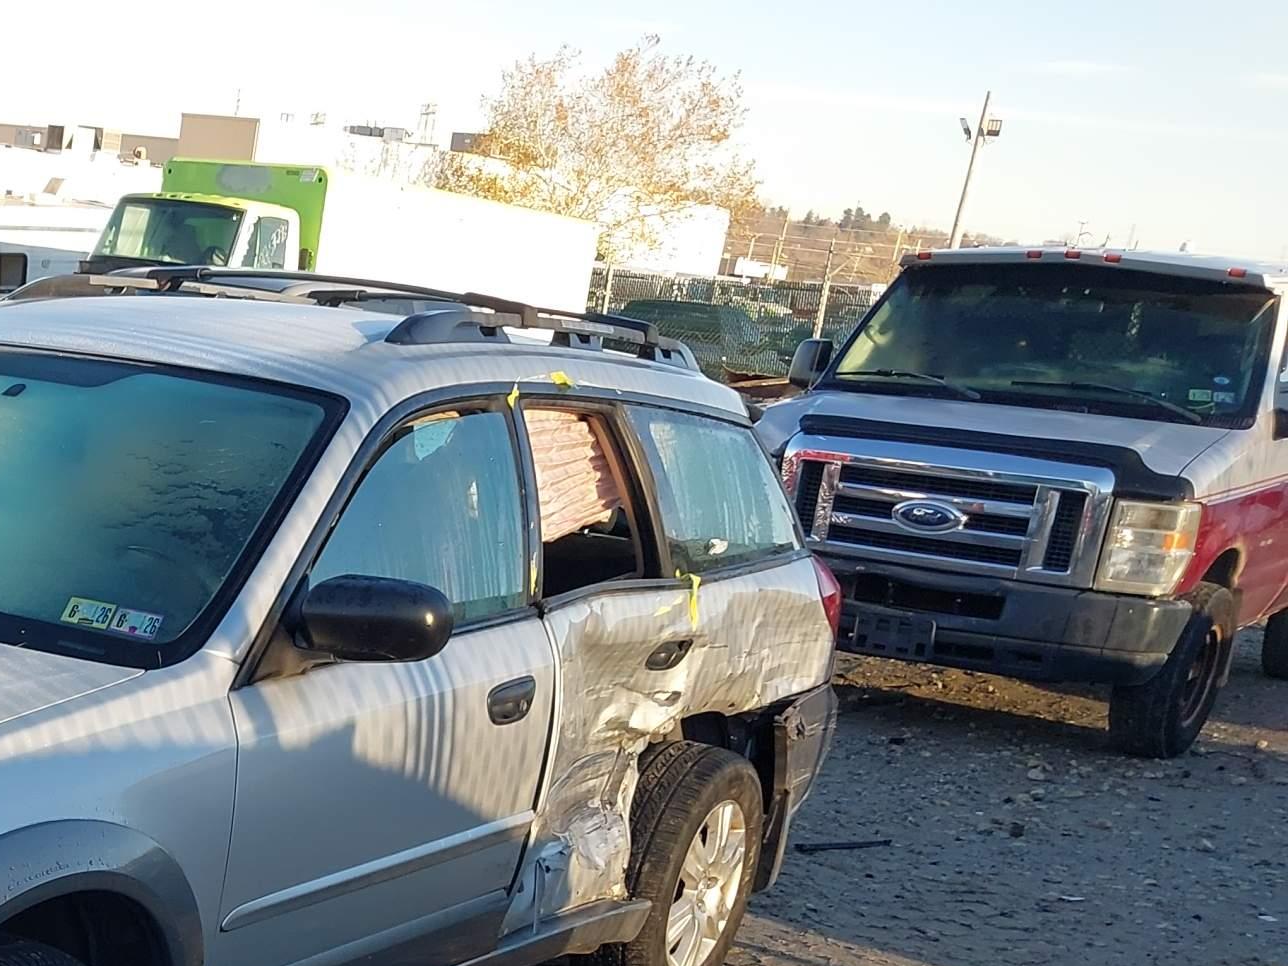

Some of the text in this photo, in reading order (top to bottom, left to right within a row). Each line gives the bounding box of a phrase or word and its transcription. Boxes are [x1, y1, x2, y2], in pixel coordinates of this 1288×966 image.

[68, 604, 112, 624] 6 26
[116, 612, 159, 634] 6 26
